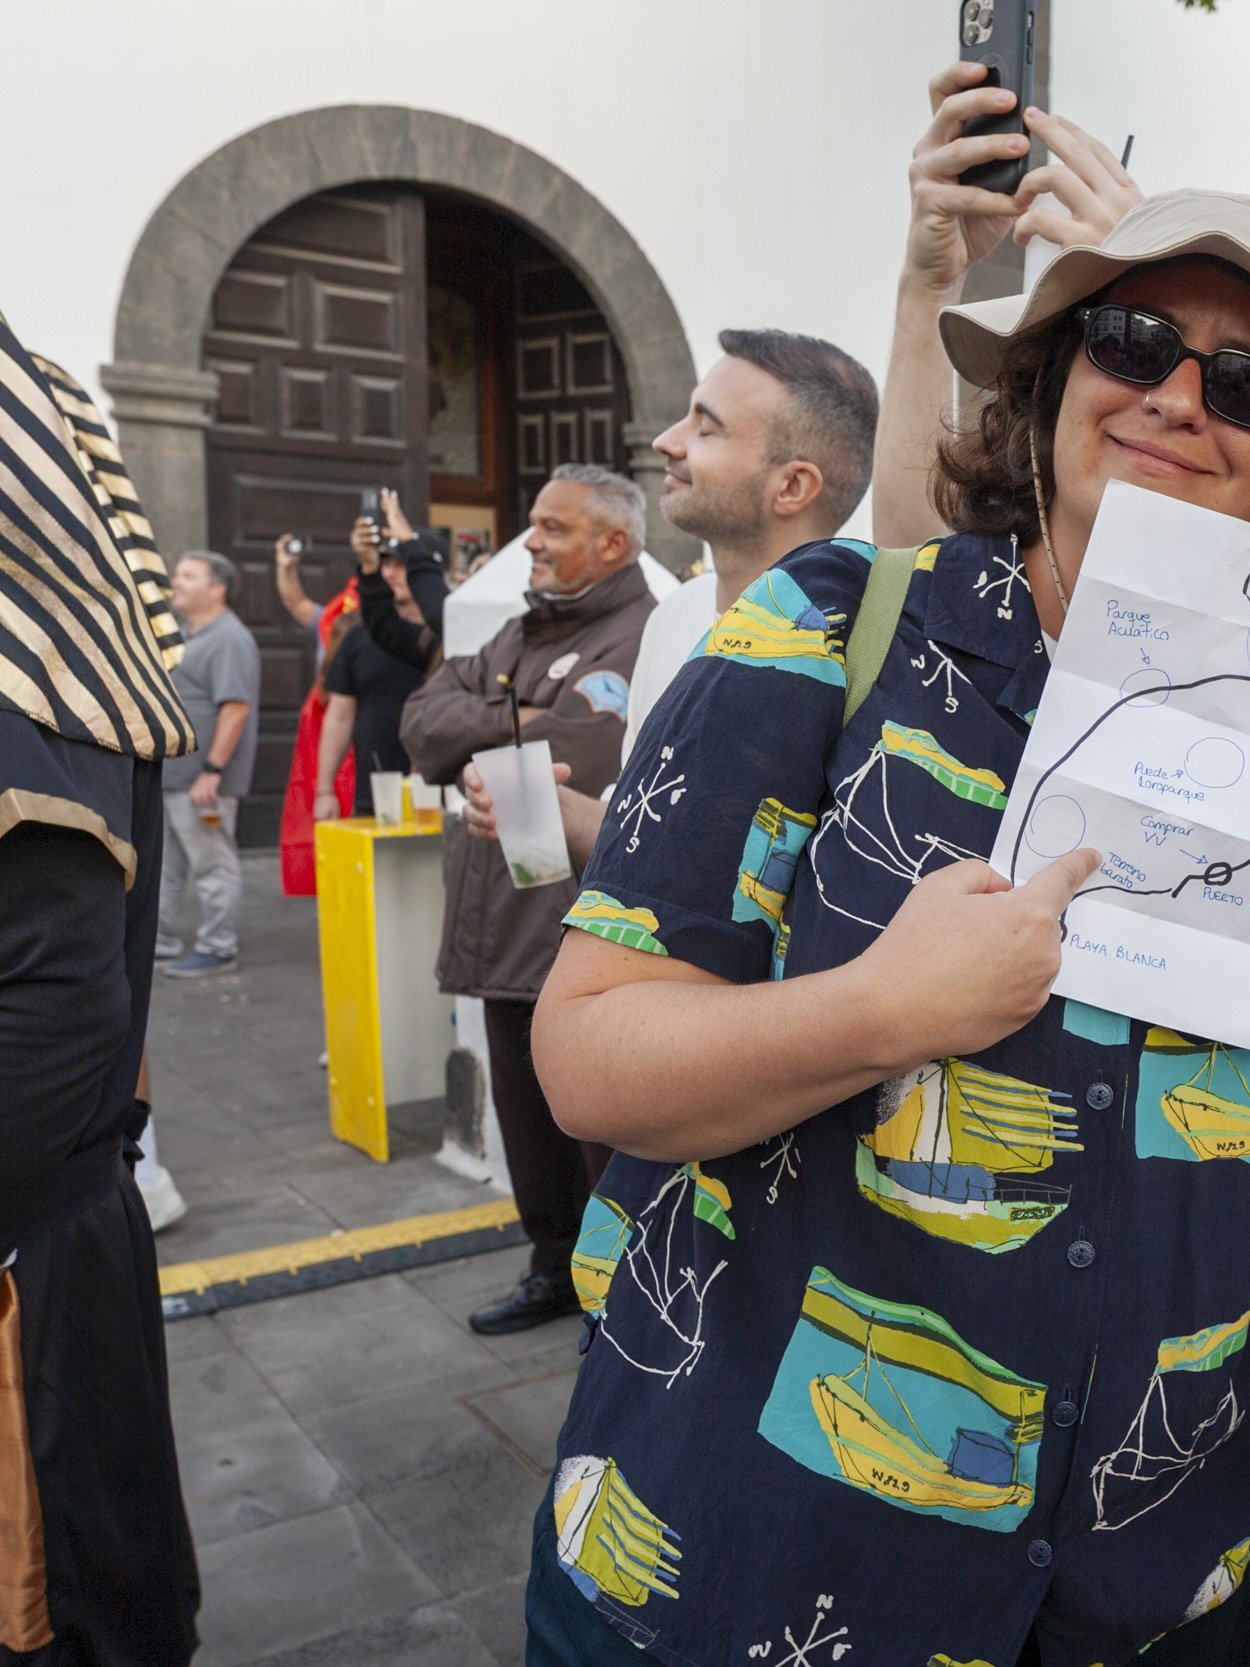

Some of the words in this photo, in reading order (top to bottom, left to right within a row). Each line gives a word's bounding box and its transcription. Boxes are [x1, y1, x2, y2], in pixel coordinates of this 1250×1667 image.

[1106, 599, 1151, 627] Parque
[1134, 761, 1168, 780] Puede
[1138, 775, 1204, 804] Loroparque
[1100, 861, 1133, 889] barato
[1108, 851, 1146, 882] Terreno
[1202, 886, 1244, 906] PUERTO
[1069, 933, 1107, 956] PLAYA
[1116, 945, 1166, 970] BLANCA
